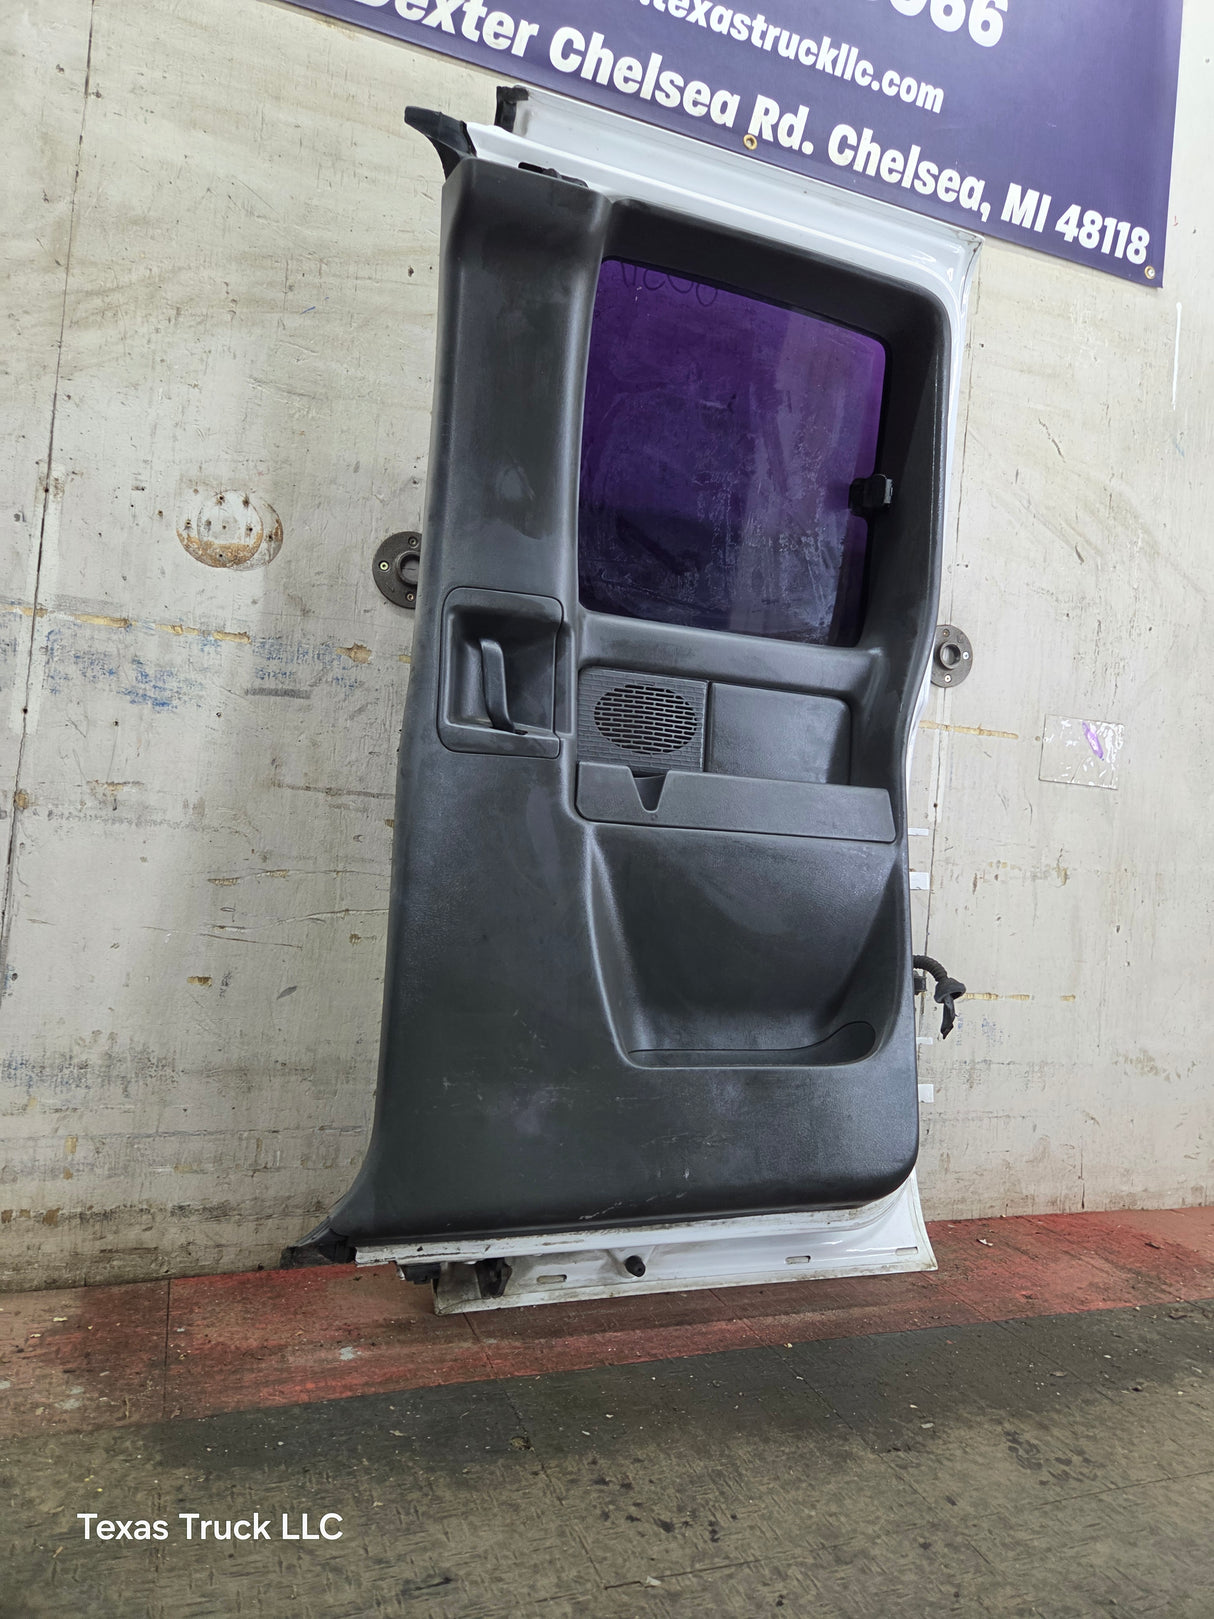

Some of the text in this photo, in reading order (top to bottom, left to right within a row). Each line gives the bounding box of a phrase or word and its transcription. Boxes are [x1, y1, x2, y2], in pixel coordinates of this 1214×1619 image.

[890, 0, 1009, 47] 66
[355, 0, 1150, 265] exter Chelsea Rd. Chelsea, MI 48118
